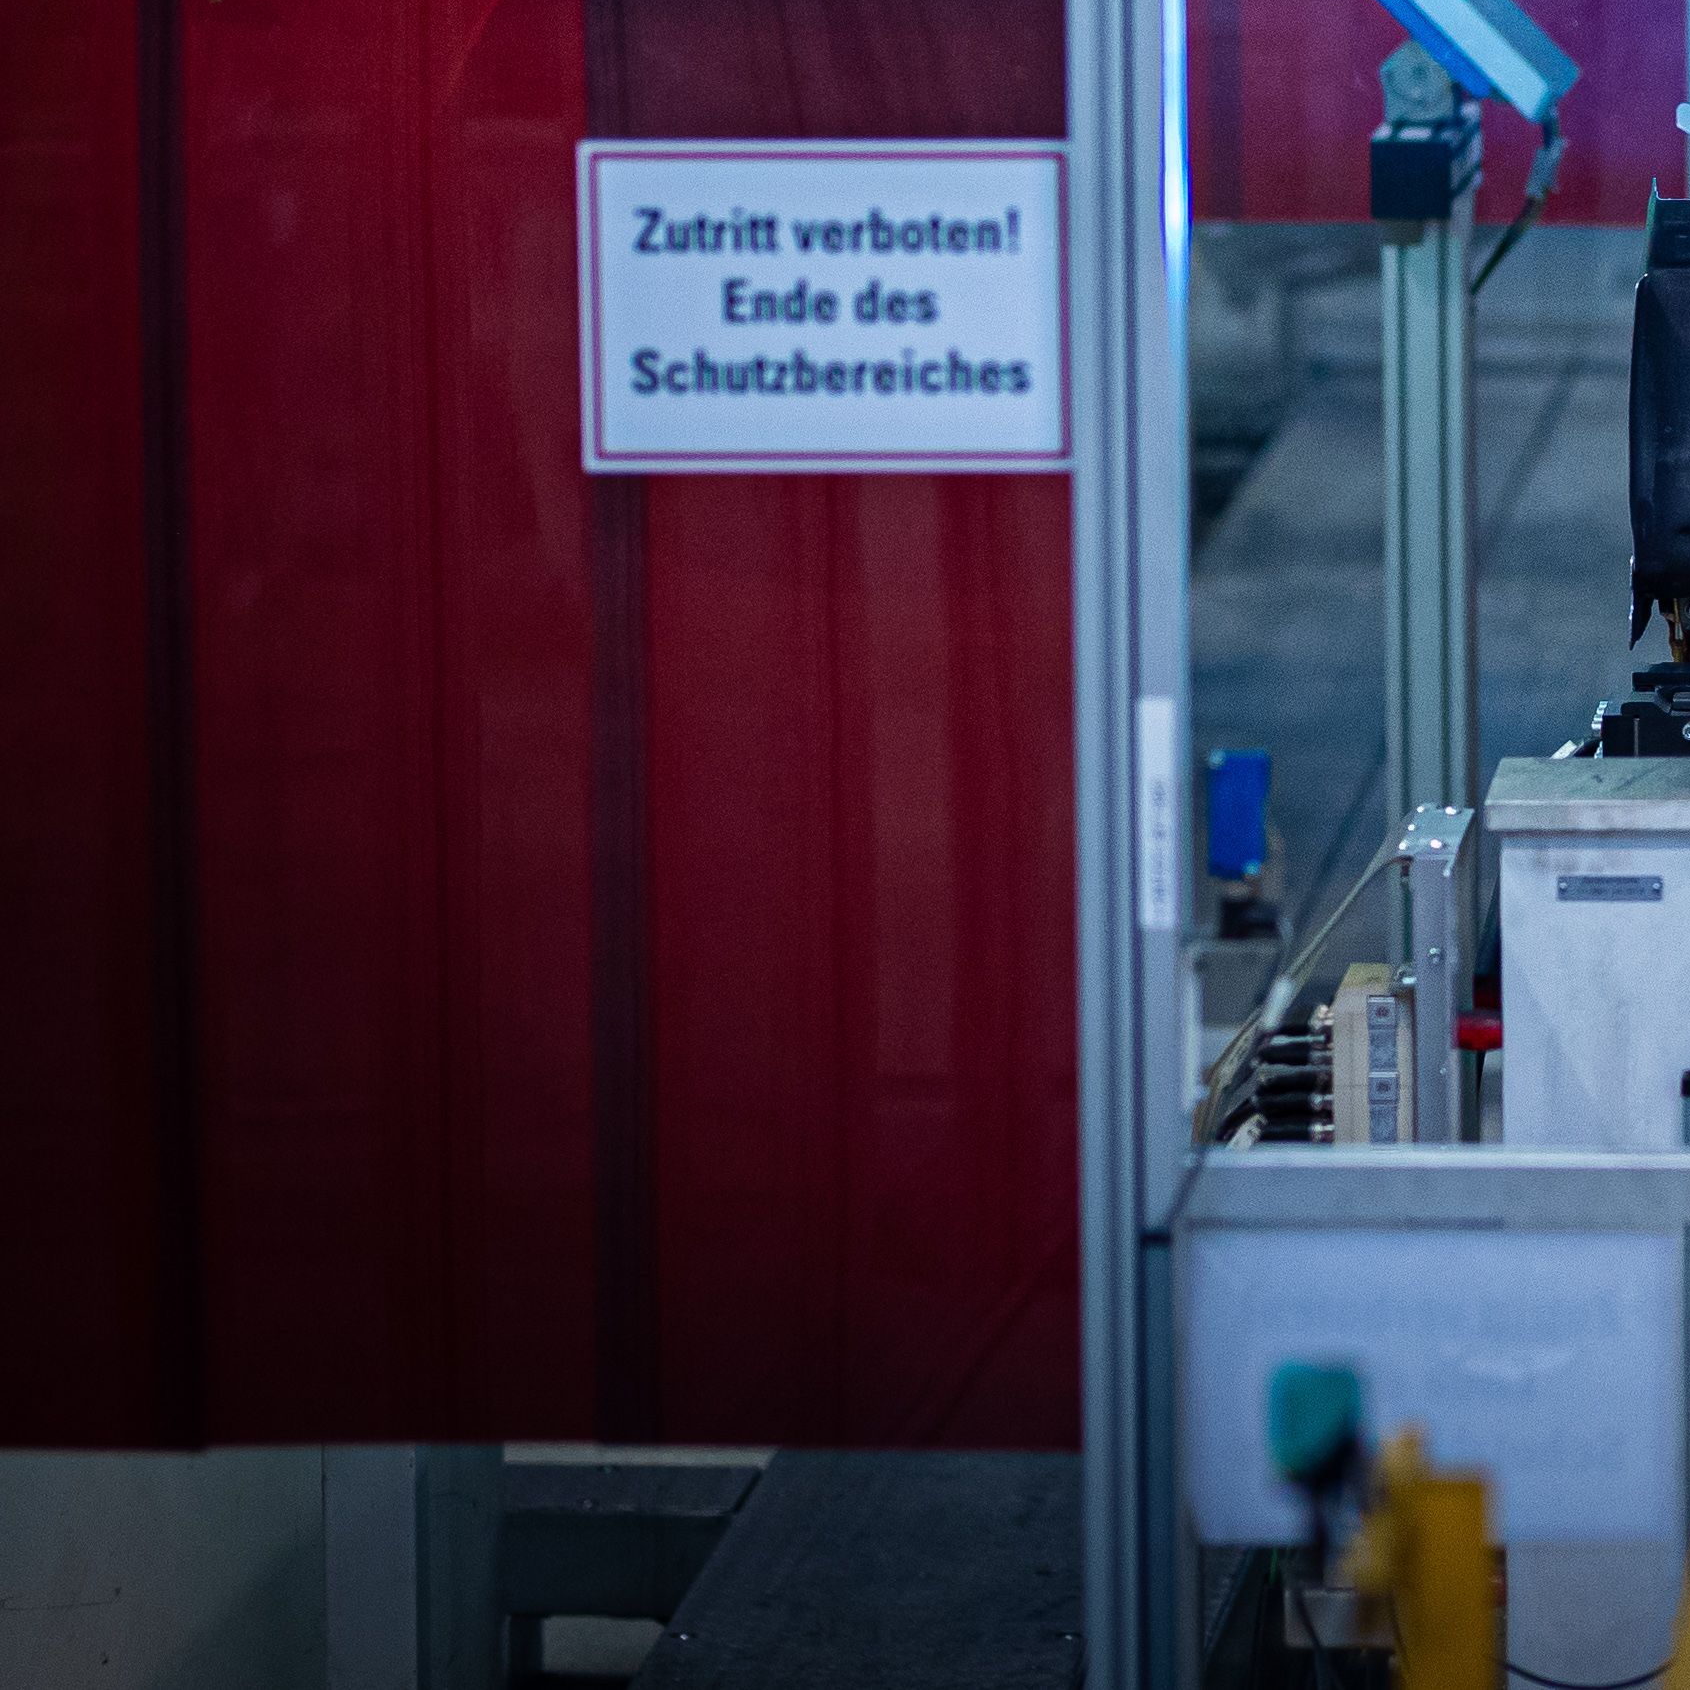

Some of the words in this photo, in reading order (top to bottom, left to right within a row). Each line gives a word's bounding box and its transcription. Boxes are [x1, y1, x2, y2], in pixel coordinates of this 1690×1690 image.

[632, 207, 780, 255] Zutritt
[791, 207, 1021, 255] verboten!
[721, 278, 839, 324] Ende
[851, 278, 939, 324] des
[630, 348, 1032, 395] Schutzbereiches
